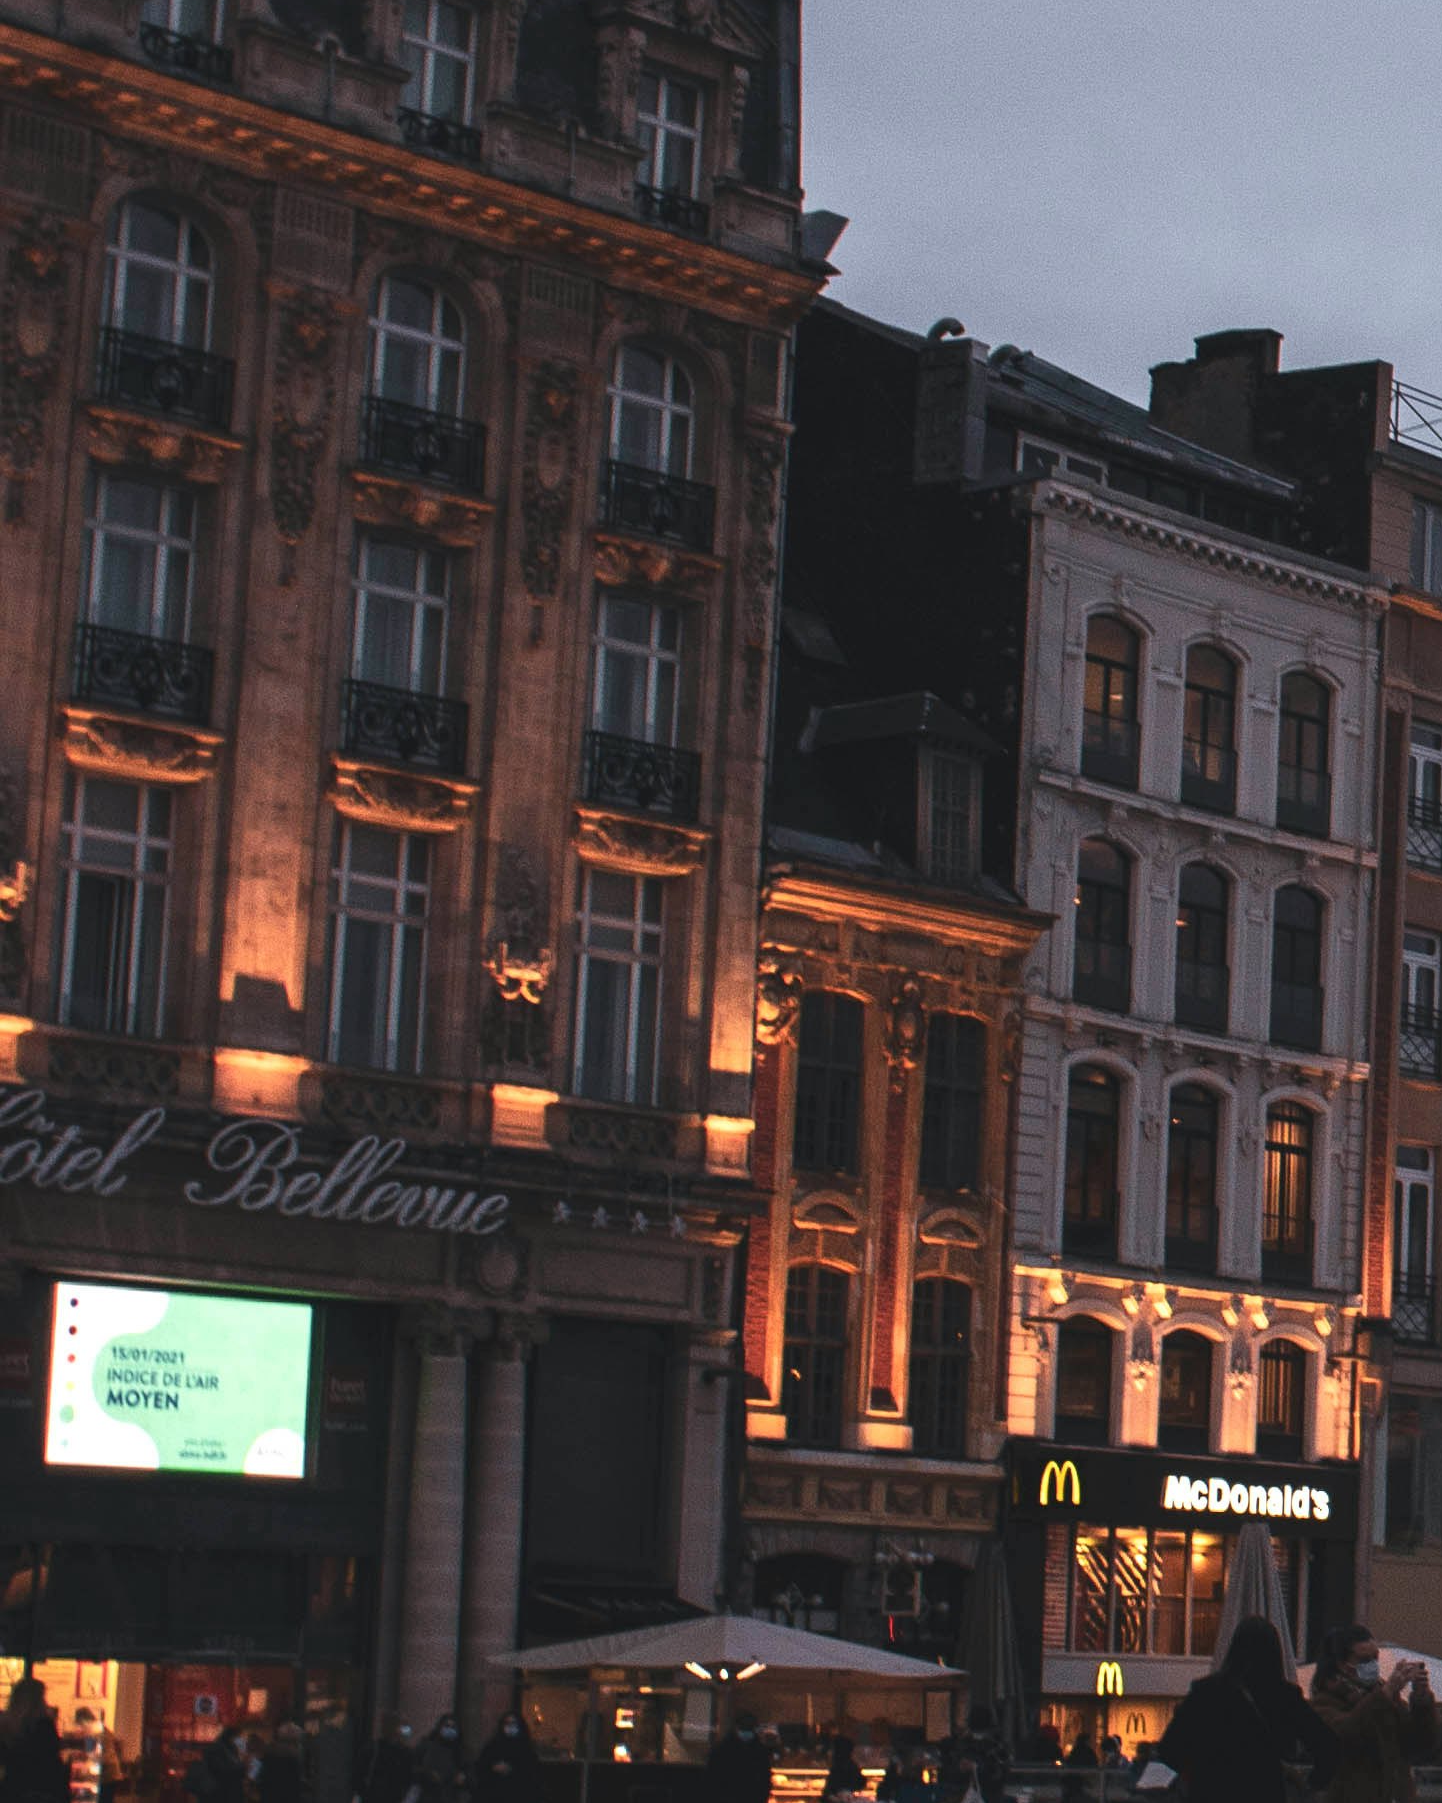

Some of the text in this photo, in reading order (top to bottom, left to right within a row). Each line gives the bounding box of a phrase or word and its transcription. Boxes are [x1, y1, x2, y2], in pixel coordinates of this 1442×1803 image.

[183, 1116, 512, 1236] Bellevue
[112, 1347, 185, 1364] 15/01/2021
[107, 1368, 220, 1391] INDICE DE L'AIR
[107, 1389, 180, 1410] MOYEN
[1163, 1475, 1330, 1520] McDonald's
